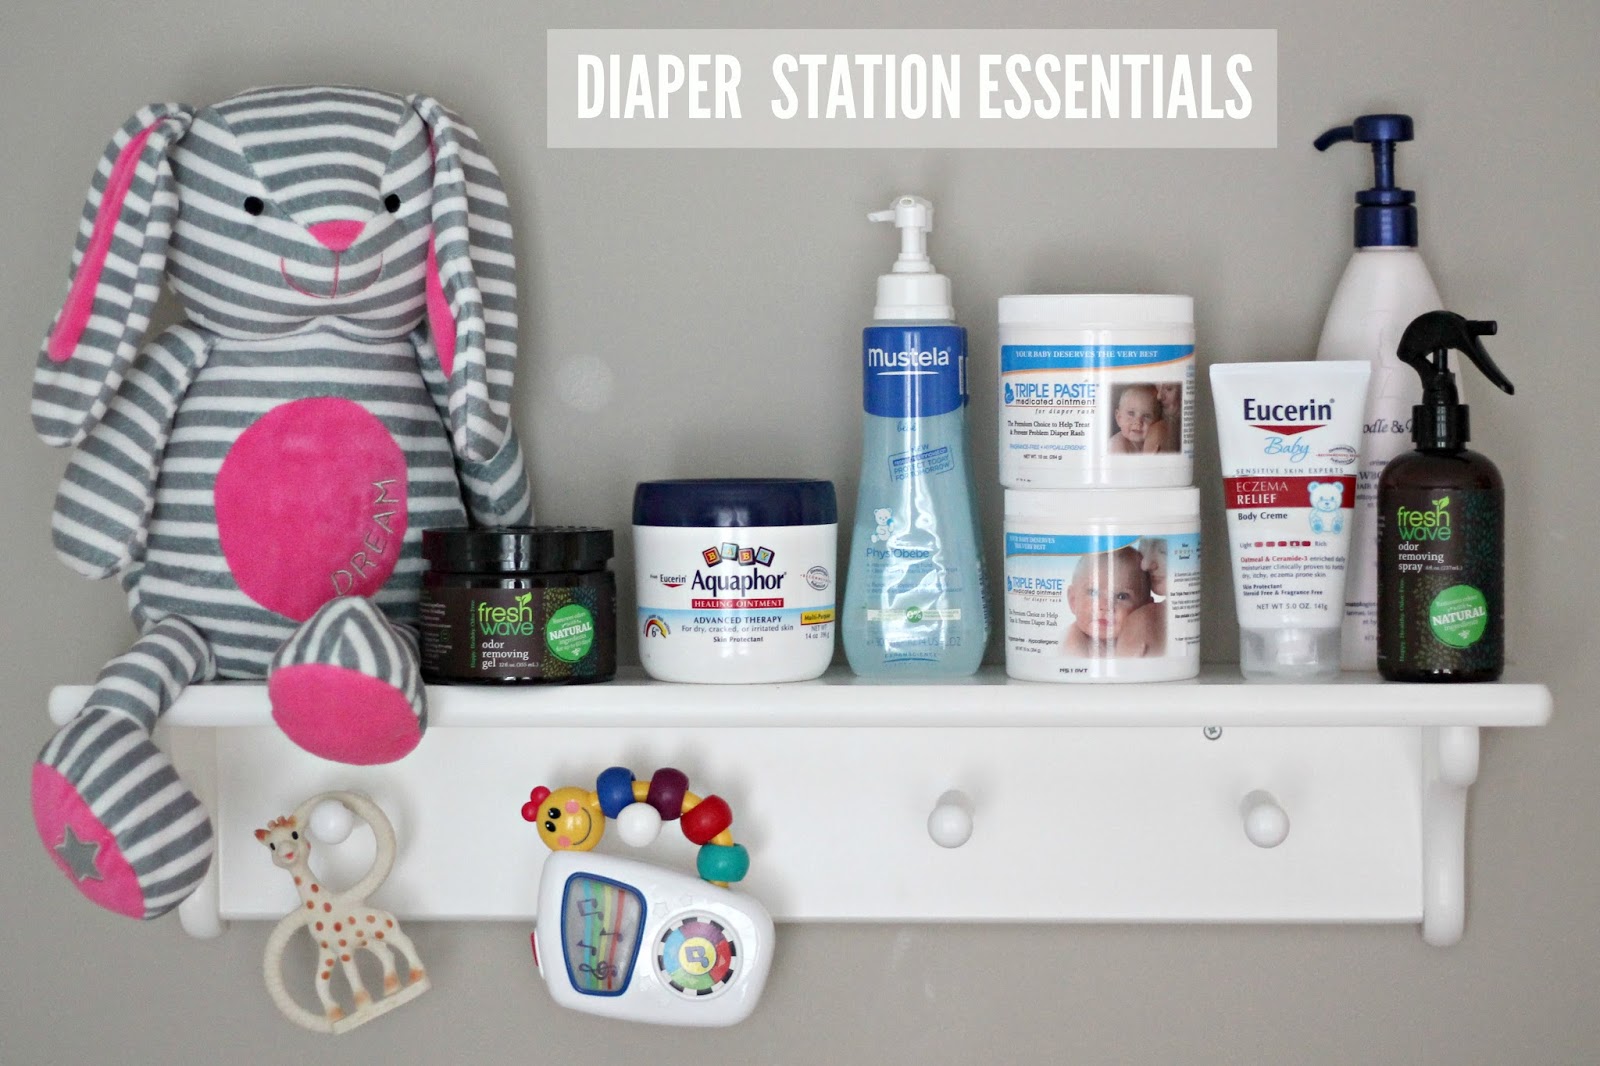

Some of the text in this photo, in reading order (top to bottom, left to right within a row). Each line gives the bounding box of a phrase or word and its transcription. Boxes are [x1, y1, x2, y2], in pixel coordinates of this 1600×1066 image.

[1015, 350, 1158, 358] YOUR BABY DESERVES THE VERY BEST
[1014, 383, 1096, 398] TRIPLE PASTE
[1049, 408, 1073, 416] diaper
[1243, 398, 1332, 421] Eucerin
[1058, 421, 1074, 429] Help
[1050, 429, 1069, 438] Diaper
[1070, 429, 1085, 437] Rash
[1264, 436, 1311, 464] Baby
[1236, 481, 1289, 493] ECZEMA
[1237, 493, 1277, 505] RELIEF
[1238, 512, 1288, 522] Body Creme
[1397, 505, 1450, 527] fresh
[331, 479, 400, 597] DREAM
[1398, 527, 1452, 541] wave
[1239, 540, 1253, 549] Light
[1398, 541, 1420, 551] odor
[1398, 551, 1445, 564] removing
[1398, 563, 1423, 574] spray
[660, 574, 687, 583] Eucerin
[691, 568, 784, 597] Aquaphor
[1013, 576, 1062, 591] TRIPLE PASTE
[1281, 589, 1310, 597] Fragrance
[694, 599, 783, 608] HEALING OINTMENT
[478, 599, 533, 622] fresh
[1046, 611, 1059, 619] Help
[1432, 606, 1486, 626] NATURAL
[693, 616, 783, 624] ADVANCED THERAPY
[1046, 619, 1058, 627] Rash
[480, 622, 535, 636] wave
[549, 622, 592, 641] NATURAL
[693, 625, 707, 634] dry,
[708, 625, 739, 633] cracked,
[751, 624, 779, 632] irritated
[482, 639, 505, 650] odor
[482, 649, 530, 661] removing
[482, 658, 497, 670] gel
